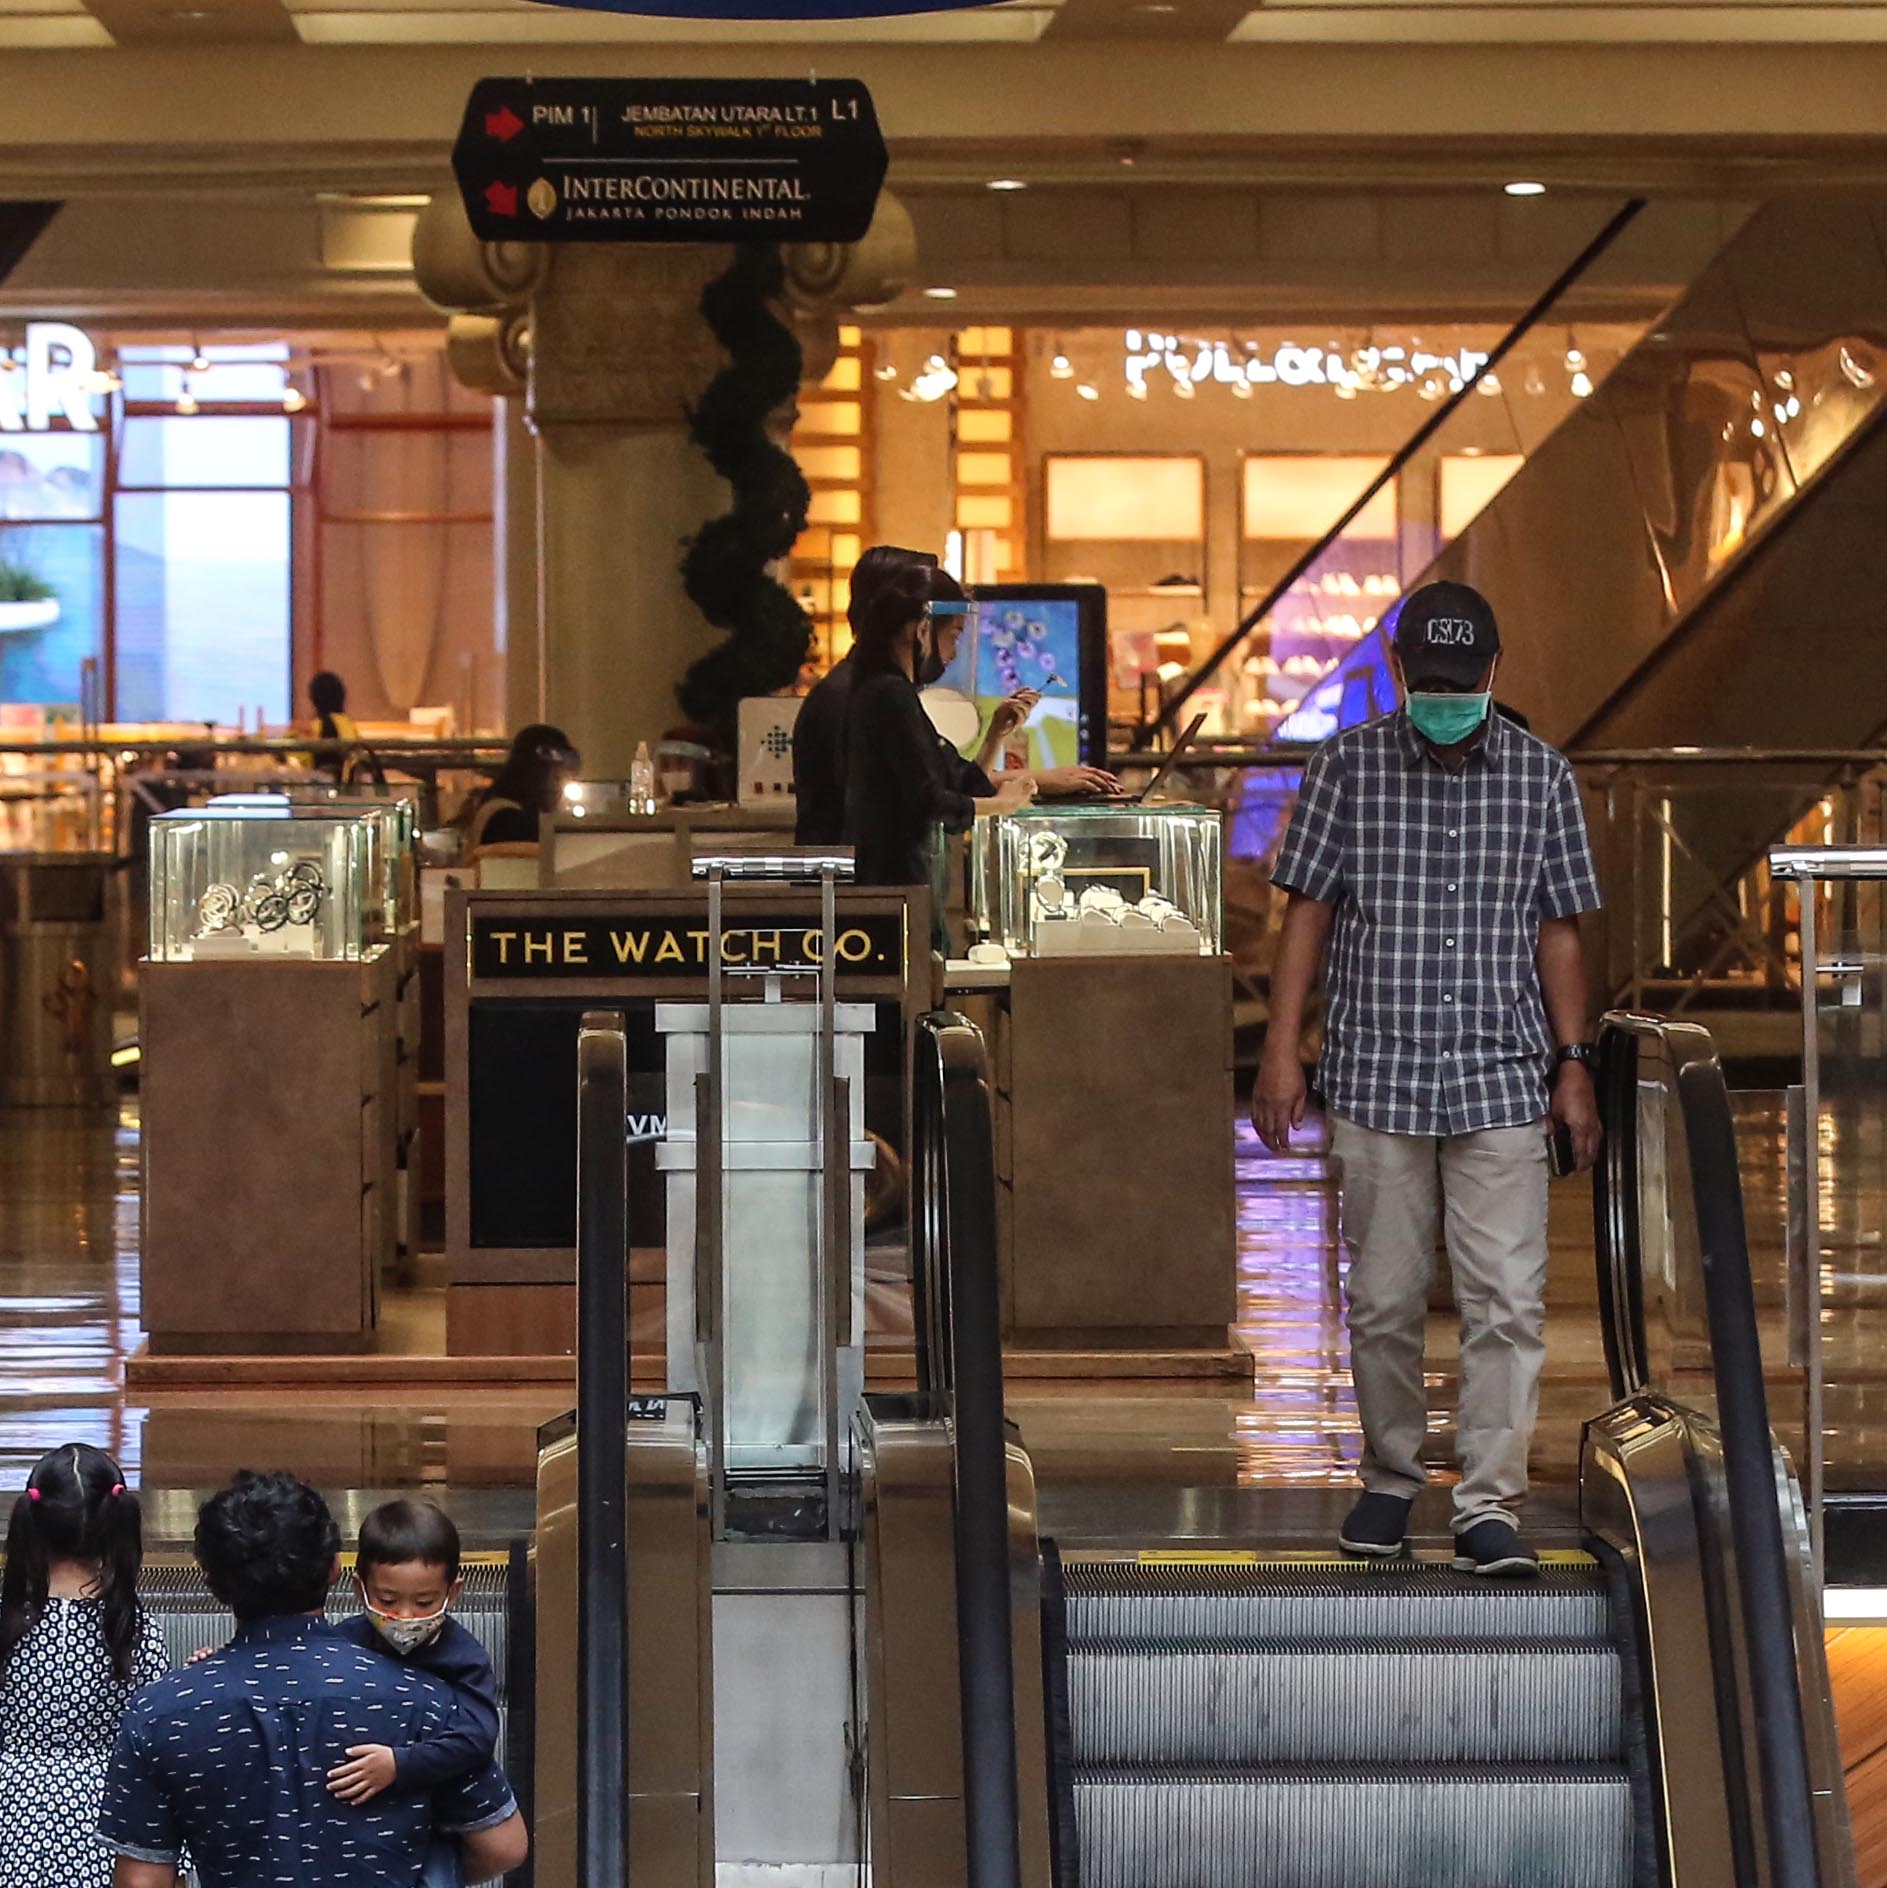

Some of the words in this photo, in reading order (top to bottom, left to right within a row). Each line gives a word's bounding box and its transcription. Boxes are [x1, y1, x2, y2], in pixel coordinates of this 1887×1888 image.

[532, 105, 574, 124] PIM
[581, 106, 590, 123] 1
[622, 104, 717, 122] JEMBATAN
[721, 105, 782, 122] UTARA
[634, 125, 683, 137] NORTH
[686, 125, 752, 137] SKYWALK
[774, 124, 823, 138] FLOOR
[566, 207, 645, 221] JAKARTA
[655, 207, 732, 220] PONDOK
[743, 207, 803, 220] INDAH
[489, 931, 589, 964] THE
[609, 930, 782, 963] WATCH
[801, 929, 885, 962] CO.
